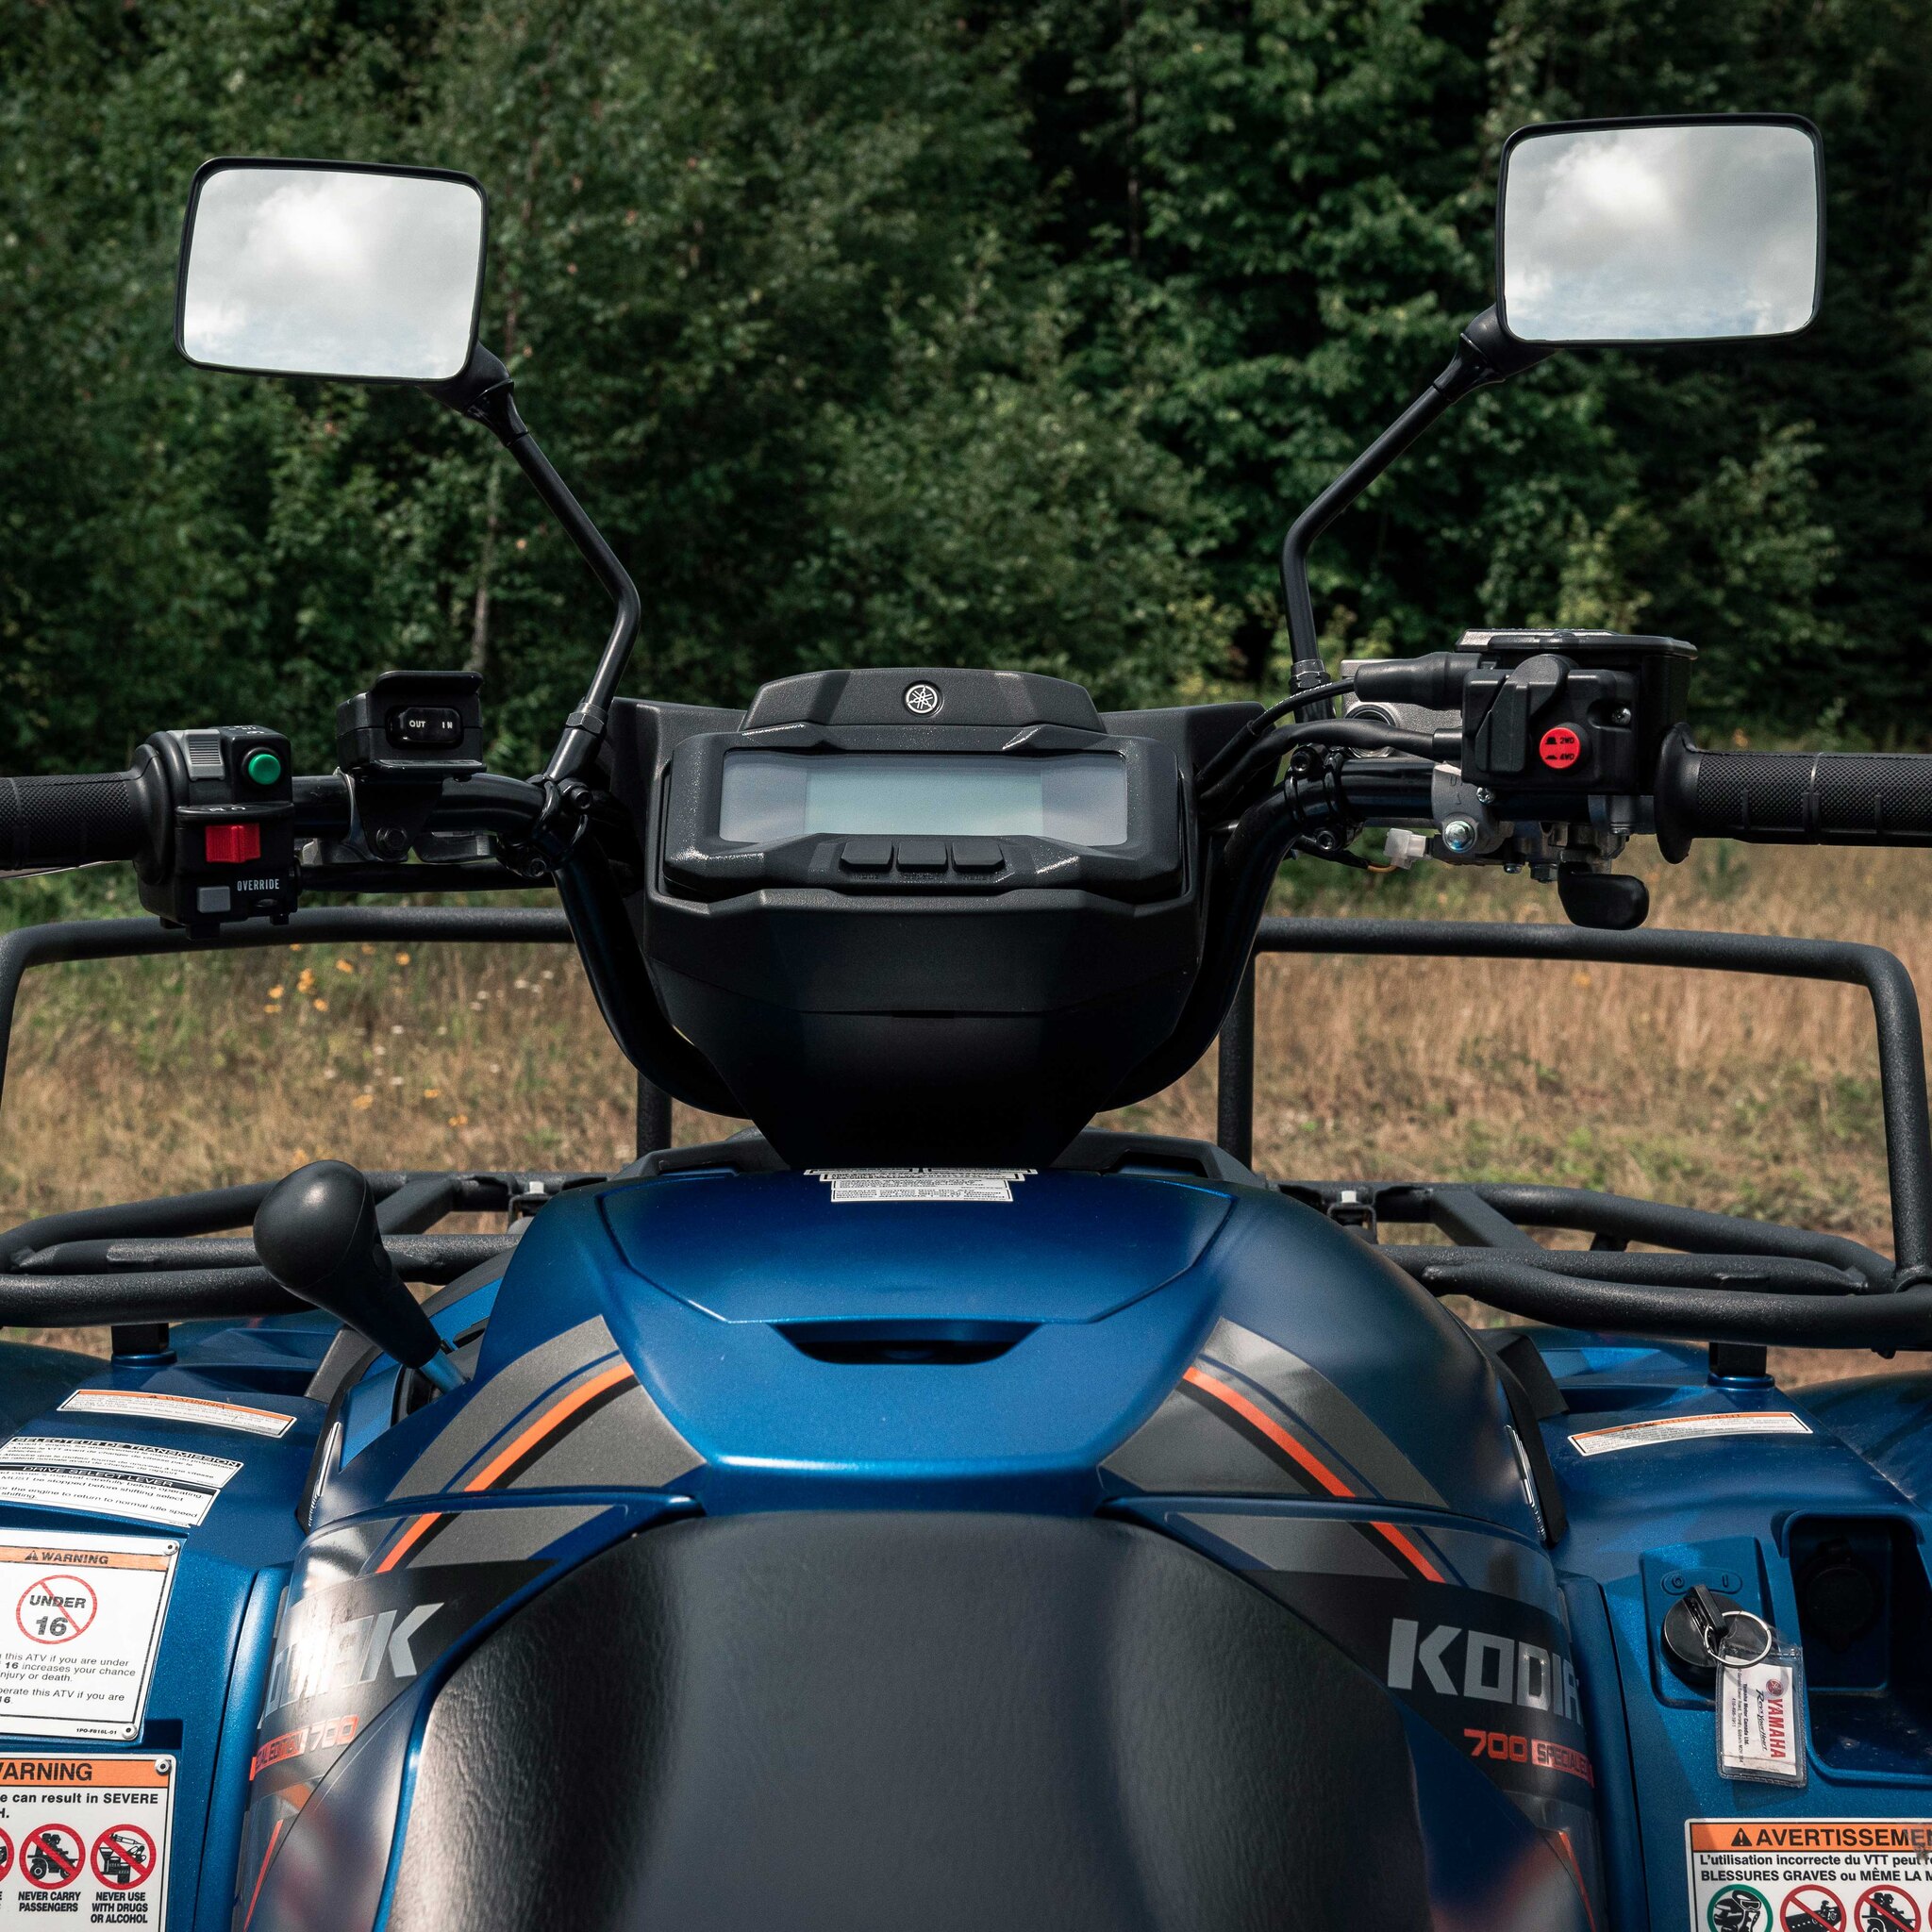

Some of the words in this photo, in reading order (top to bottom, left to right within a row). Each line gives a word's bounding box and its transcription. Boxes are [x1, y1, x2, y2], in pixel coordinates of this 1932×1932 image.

[441, 721, 453, 729] IN
[237, 878, 280, 891] OVERRIDE
[68, 1469, 125, 1479] SELECT
[127, 1475, 174, 1487] LEVER
[86, 1476, 125, 1486] carefully
[126, 1482, 157, 1491] before
[158, 1487, 204, 1500] operating.
[120, 1488, 154, 1497] shifting
[156, 1492, 184, 1502] select
[115, 1500, 149, 1509] normal
[169, 1508, 198, 1519] speed
[42, 1552, 109, 1565] WARNING
[29, 1594, 87, 1608] UNDER
[36, 1616, 69, 1637] 16
[5, 1653, 24, 1661] this
[25, 1654, 48, 1662] ATV
[49, 1655, 58, 1663] if
[58, 1657, 78, 1665] you
[80, 1657, 98, 1666] are
[100, 1658, 130, 1668] under
[5, 1661, 20, 1670] 16
[22, 1661, 71, 1673] increases
[74, 1664, 97, 1674] your
[99, 1666, 137, 1677] chance
[1387, 1617, 1585, 1729] KODIA
[42, 1674, 74, 1683] death.
[32, 1688, 51, 1697] this
[52, 1690, 75, 1699] ATV
[76, 1690, 85, 1699] if
[85, 1692, 107, 1702] you
[108, 1693, 125, 1702] are
[308, 1714, 359, 1753] 700
[1767, 1698, 1787, 1758] YAMAHA
[1463, 1728, 1528, 1763] 700
[0, 1762, 93, 1781] ARNING
[12, 1794, 37, 1803] can
[41, 1793, 82, 1804] result
[86, 1793, 99, 1804] in
[103, 1793, 158, 1805] SEVERE
[1776, 1855, 1841, 1865] incorrecte
[1844, 1855, 1860, 1865] du
[1864, 1855, 1889, 1865] VTT
[1892, 1856, 1921, 1868] peut
[1701, 1870, 1779, 1881] BLESSURES
[1783, 1870, 1837, 1881] GRAVES
[1840, 1873, 1857, 1881] ou
[1860, 1867, 1901, 1881] MÊME
[1905, 1871, 1923, 1881] LA
[18, 1891, 48, 1901] NEVER
[50, 1891, 81, 1901] CARRY
[96, 1891, 125, 1902] NEVER
[127, 1891, 146, 1902] USE
[19, 1903, 78, 1912] PASSENGERS
[92, 1903, 115, 1912] WITH
[117, 1903, 148, 1912] DRUGS
[91, 1914, 104, 1924] OR
[106, 1914, 148, 1924] ALCOHOL
